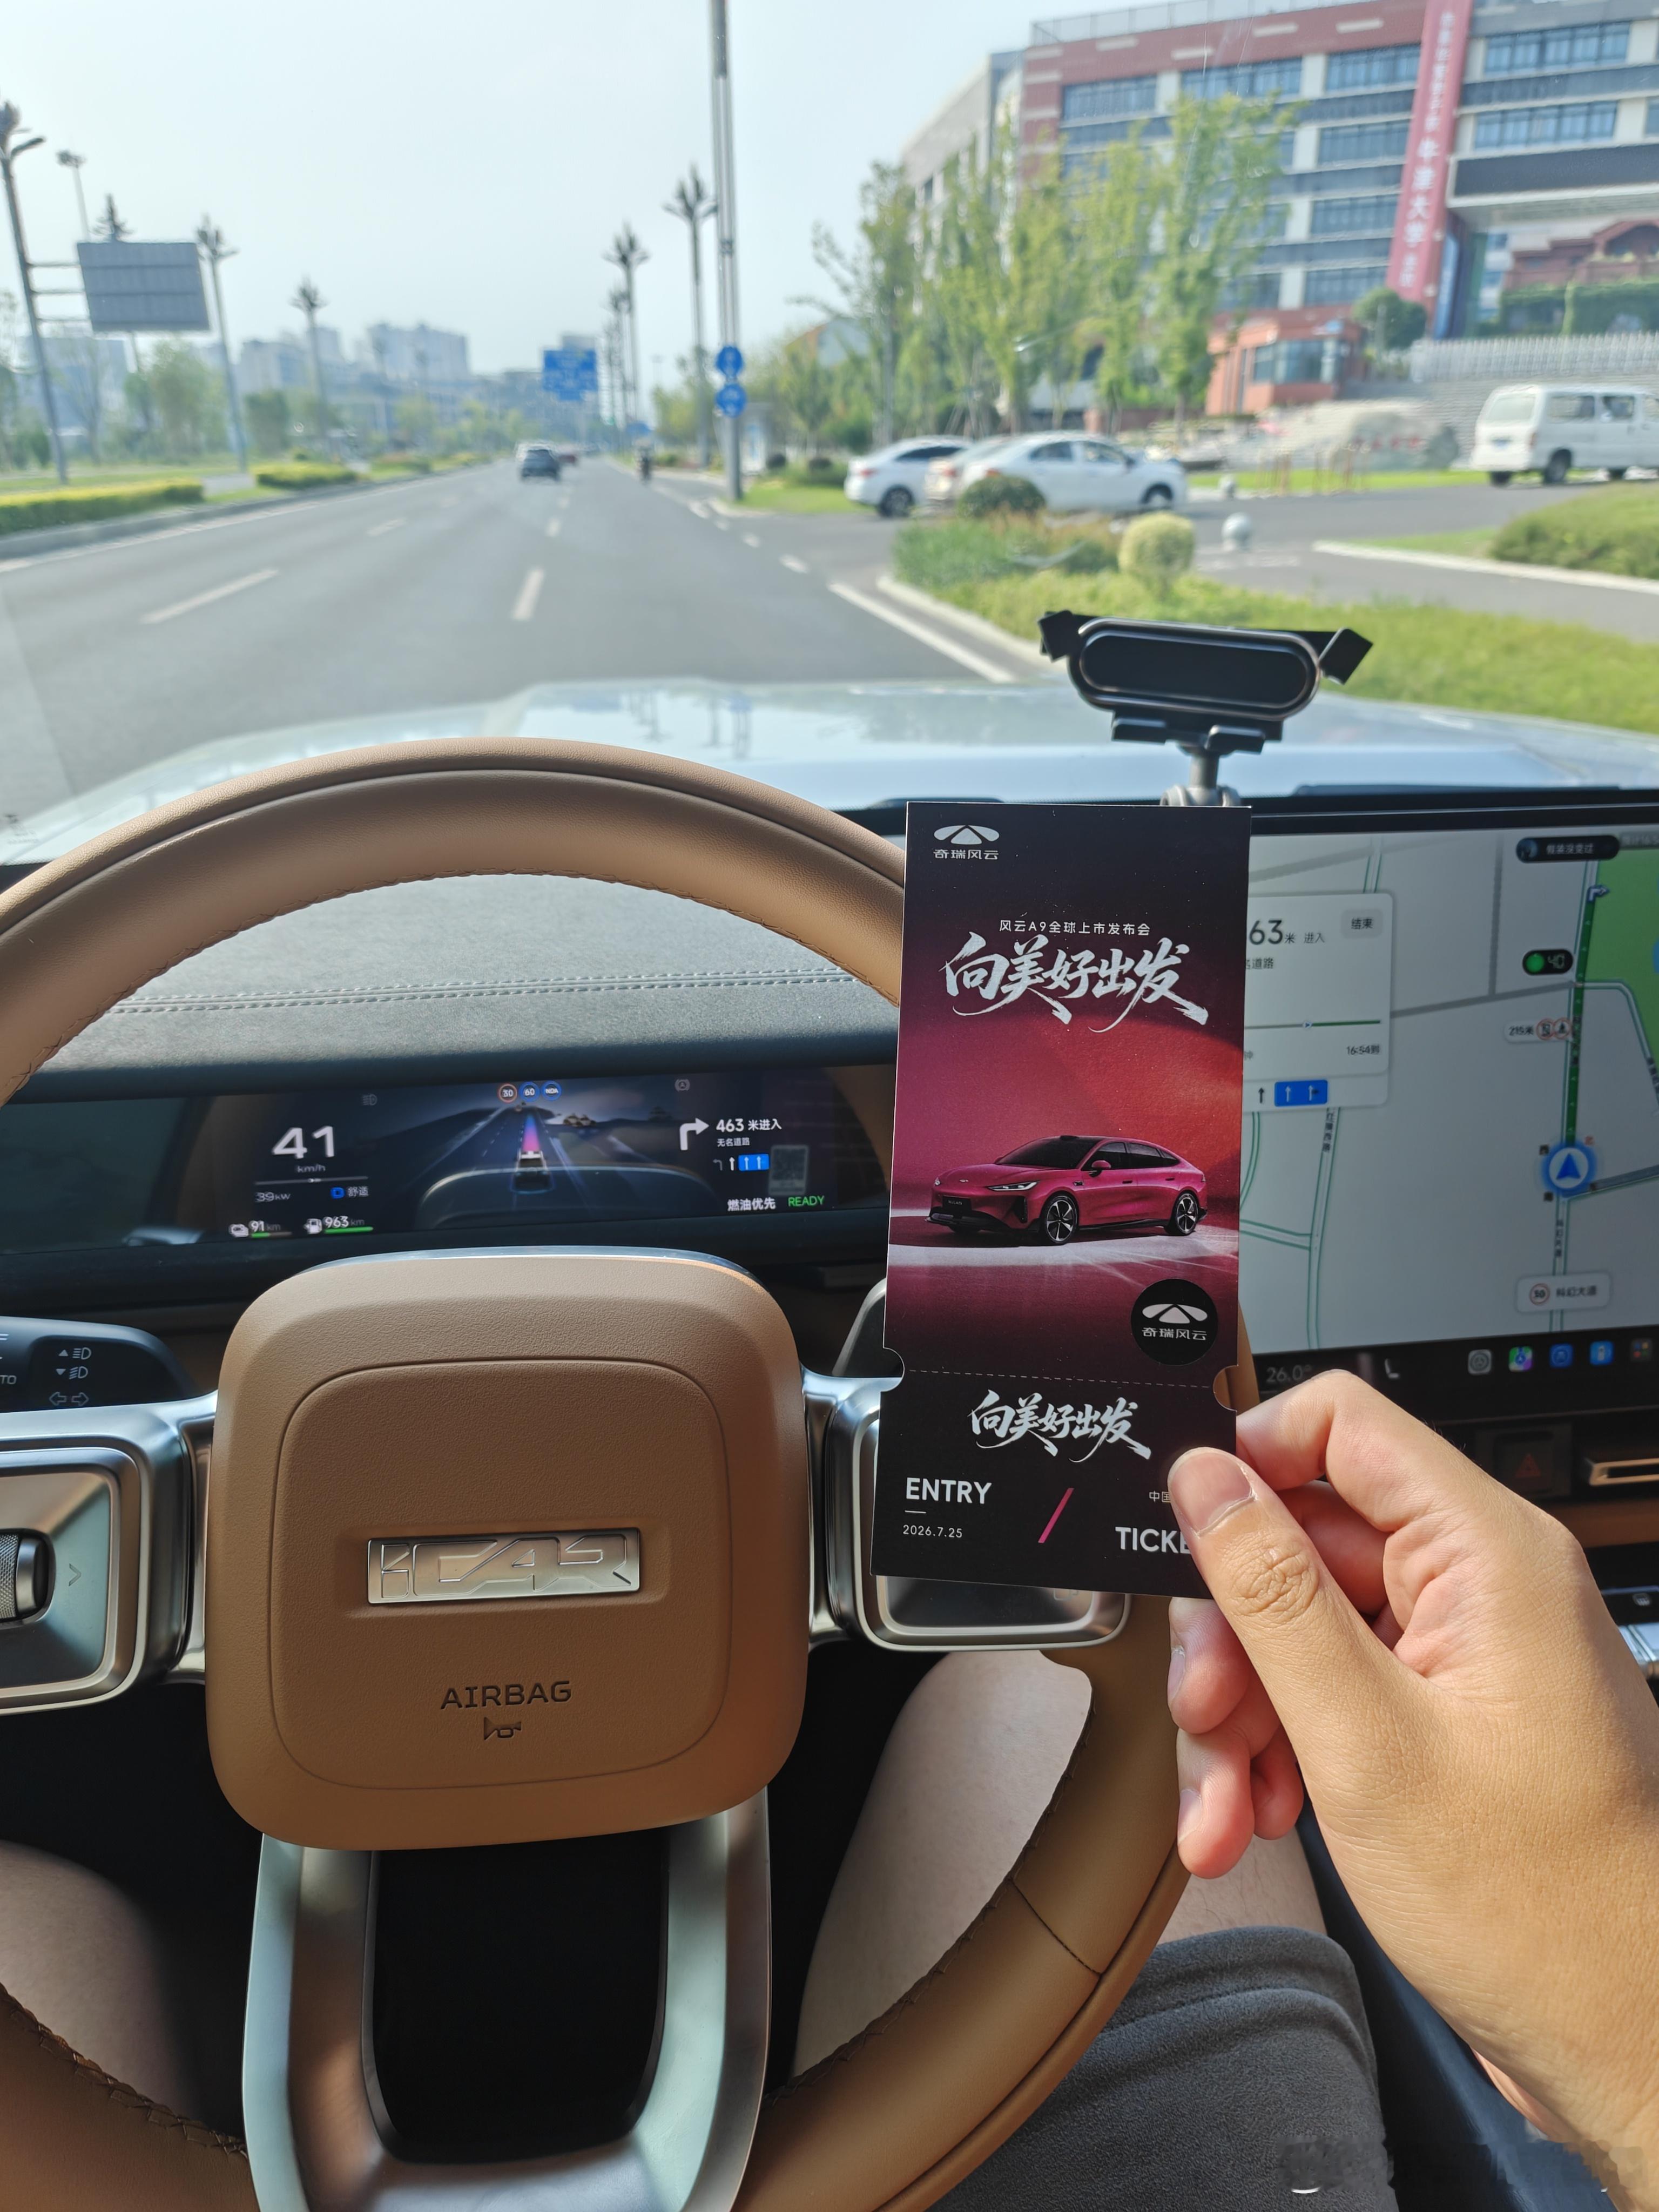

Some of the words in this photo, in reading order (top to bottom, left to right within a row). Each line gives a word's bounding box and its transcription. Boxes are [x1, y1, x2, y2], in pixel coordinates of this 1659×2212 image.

[933, 848, 999, 860] 奇瑞风云
[999, 919, 1151, 936] 风云A9全球上市发布会
[1351, 918, 1373, 929] 结束
[1303, 932, 1325, 944] 进入
[939, 931, 1209, 1034] 向美好出发
[524, 1087, 535, 1096] 60
[716, 1118, 745, 1132] 463
[747, 1118, 782, 1131] 米进入
[272, 1125, 335, 1159] 41
[717, 1137, 750, 1148] 无名道路
[295, 1164, 326, 1174] km/h
[727, 1197, 776, 1212] 燃油优先
[788, 1195, 825, 1208] READY
[249, 1220, 266, 1232] 91
[323, 1215, 349, 1228] 963
[350, 1218, 365, 1226] km
[1141, 1327, 1208, 1341] 奇瑞风云
[967, 1389, 1151, 1462] 向美好出发
[906, 1477, 992, 1505] ENTRY
[902, 1525, 963, 1538] 2026.7.25
[440, 1680, 572, 1710] AIRBAG
